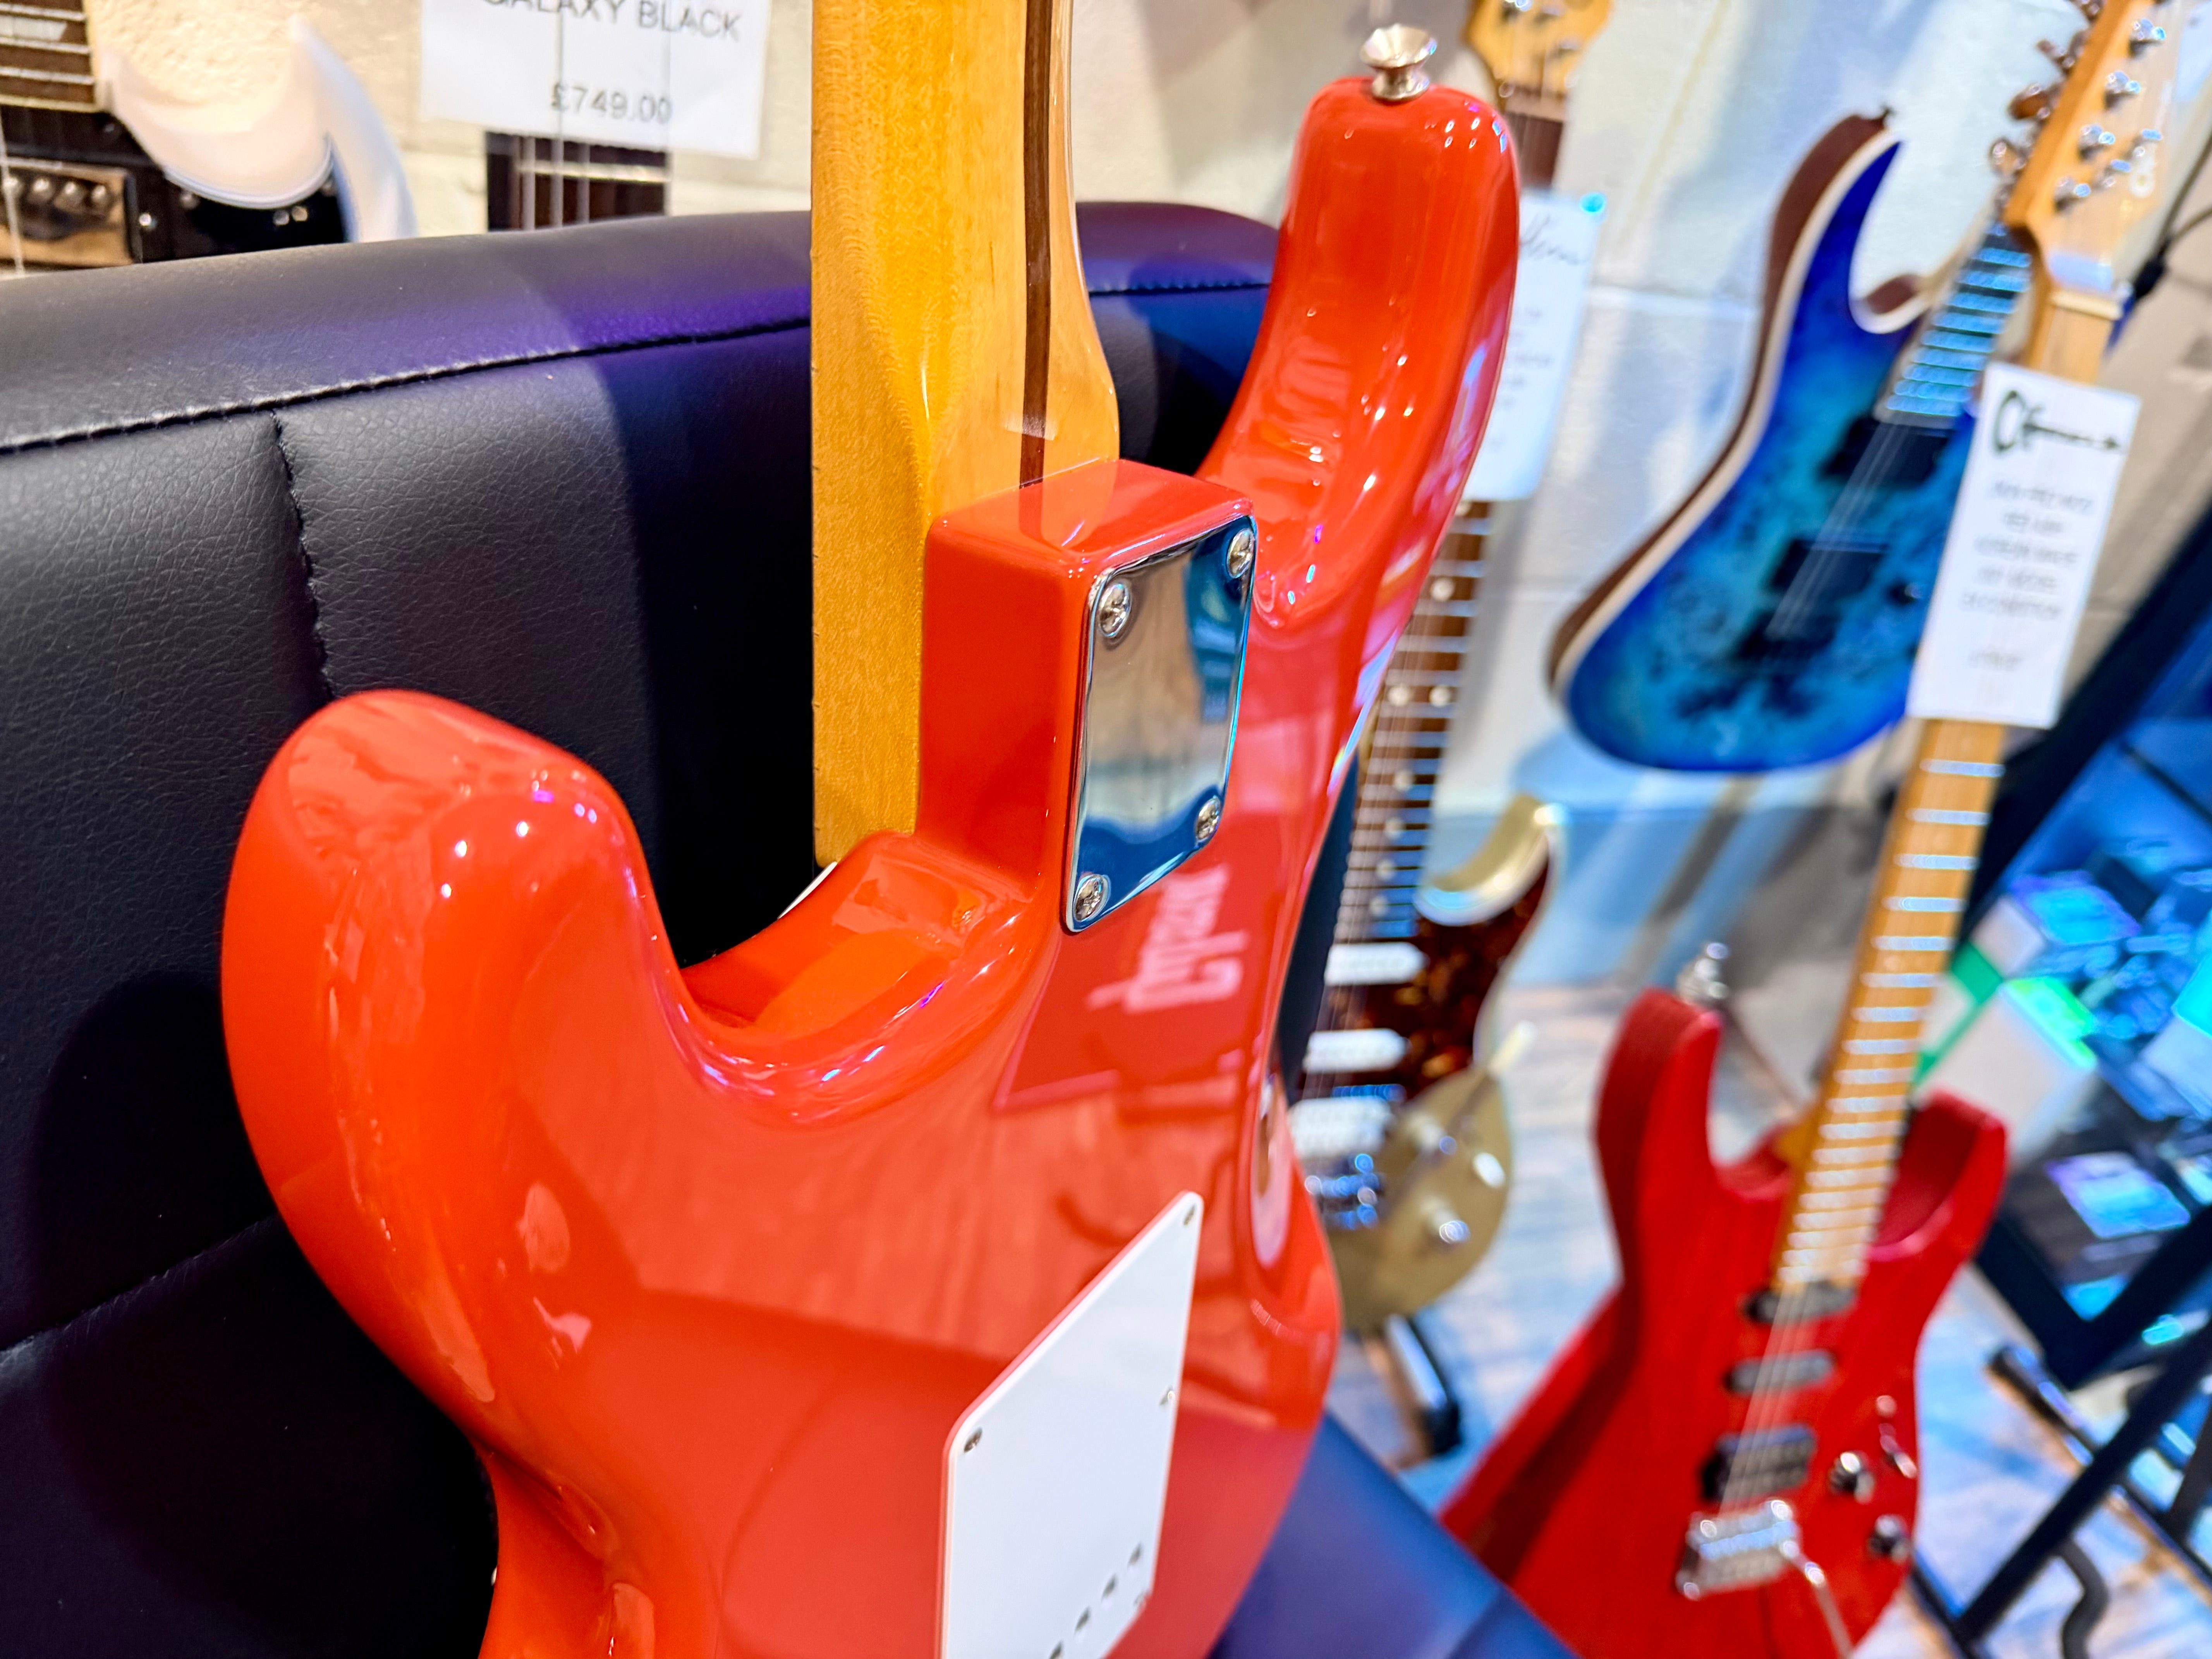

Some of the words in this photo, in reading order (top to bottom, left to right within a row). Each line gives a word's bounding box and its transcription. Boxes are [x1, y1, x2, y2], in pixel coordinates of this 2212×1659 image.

[482, 0, 624, 23] AXY
[639, 0, 742, 41] BLACK
[551, 82, 672, 124] £749.00
